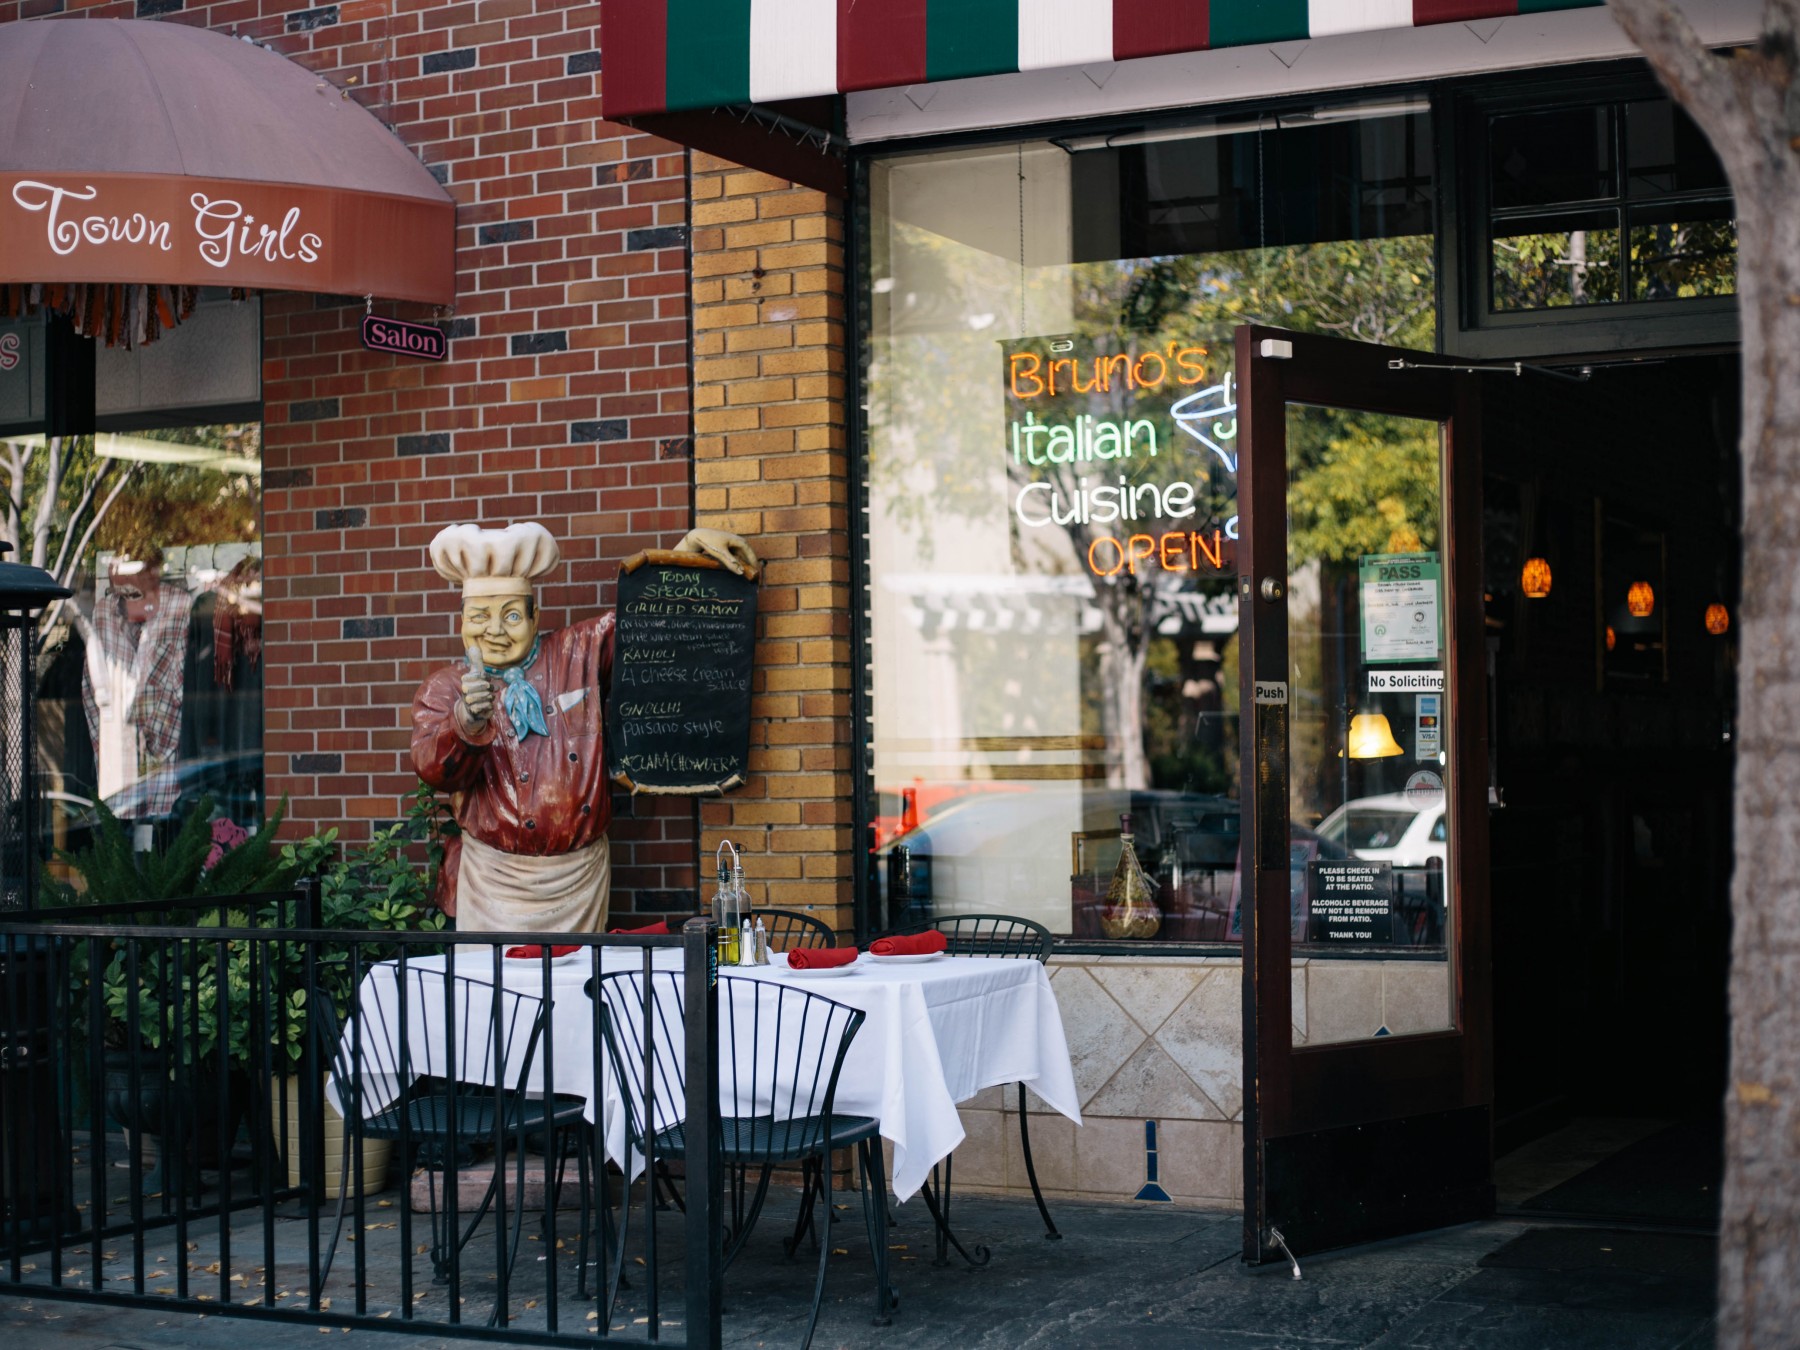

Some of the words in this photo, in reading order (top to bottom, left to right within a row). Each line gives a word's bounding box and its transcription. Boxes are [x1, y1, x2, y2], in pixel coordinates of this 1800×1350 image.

[12, 180, 172, 256] Town
[190, 192, 322, 268] Girls
[371, 323, 438, 354] Salon
[1009, 340, 1208, 398] Bruno's
[1012, 411, 1158, 466] Italian
[1015, 474, 1197, 527] Cuisine
[1088, 529, 1222, 576] OPEN
[659, 571, 700, 585] TODAY
[1379, 565, 1422, 580] PASS
[643, 584, 718, 598] SPECIALS
[625, 602, 686, 615] GRILLED
[692, 603, 739, 615] SALMON
[623, 648, 676, 661] RAVIOLI
[621, 667, 636, 687] 4
[1369, 675, 1387, 688] No
[1389, 674, 1445, 691] Soliciting
[1256, 686, 1284, 699] Push
[619, 701, 682, 716] GNOCCHI
[631, 752, 671, 773] CLAM
[671, 752, 729, 772] CHOWDER
